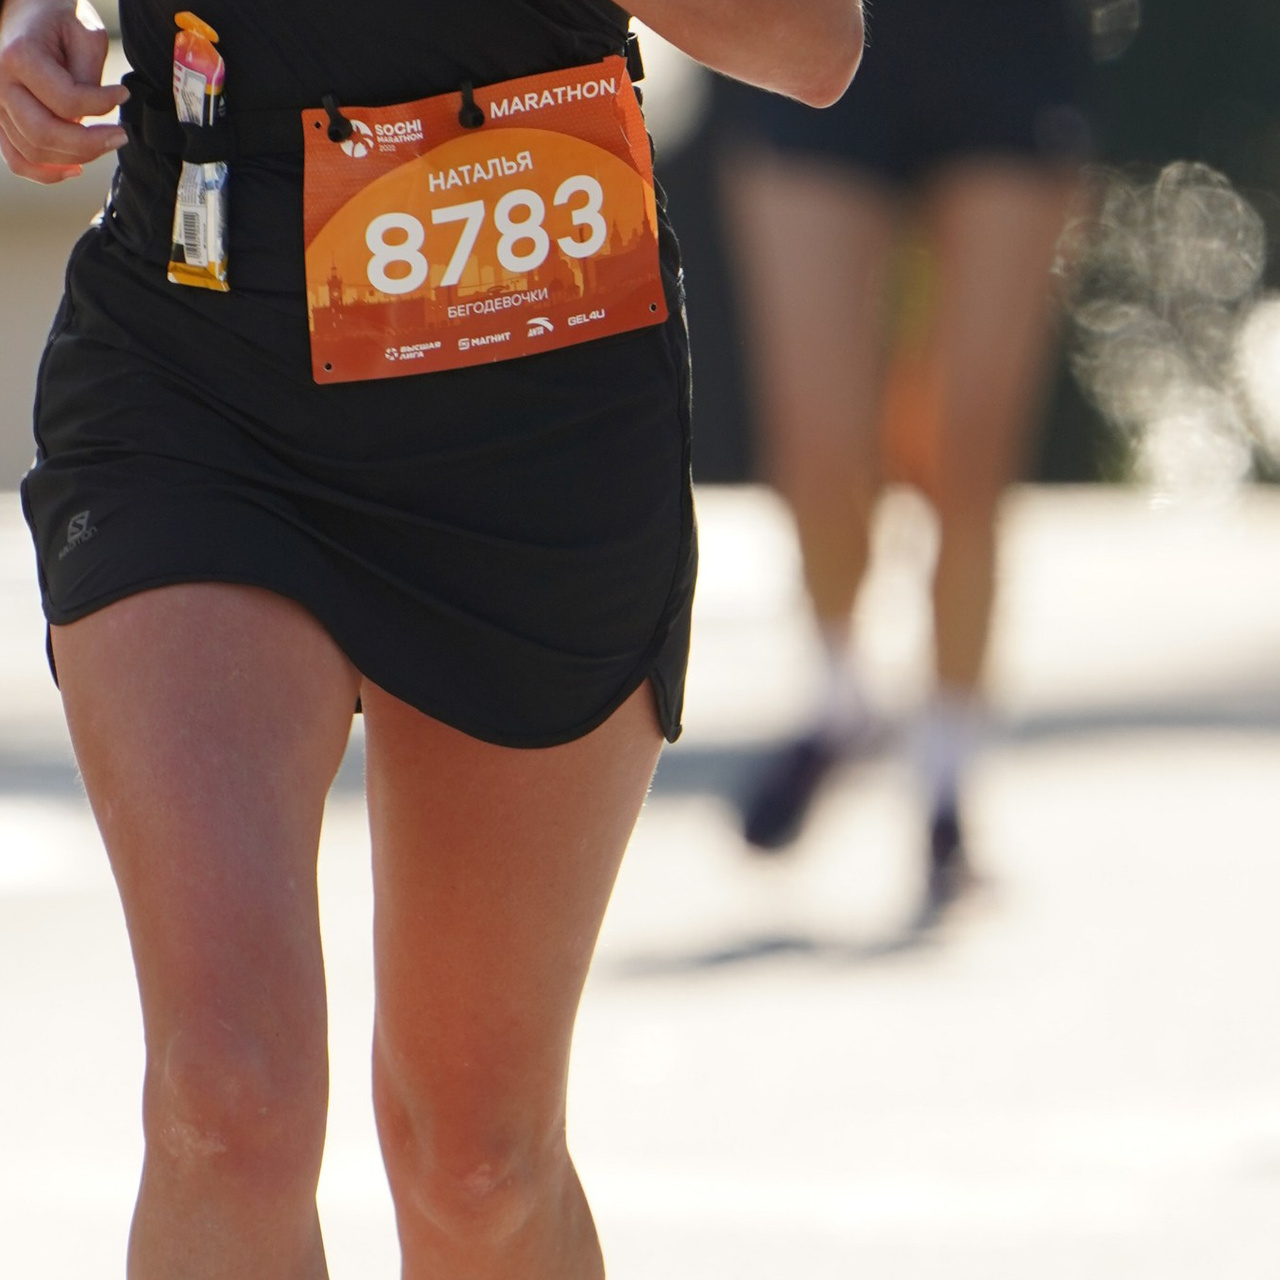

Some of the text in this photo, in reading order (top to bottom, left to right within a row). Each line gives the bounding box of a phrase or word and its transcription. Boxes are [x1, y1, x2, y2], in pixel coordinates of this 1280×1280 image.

[490, 77, 616, 119] MARATHON
[374, 119, 422, 135] SOCHI
[376, 132, 424, 143] MARATHON
[428, 150, 534, 193] НАТАЛЬЯ
[364, 173, 608, 295] 8783
[447, 287, 549, 319] БЕГОДЕВОЧКИ
[567, 308, 606, 327] GEL4U
[471, 331, 511, 347] МАГНИТ
